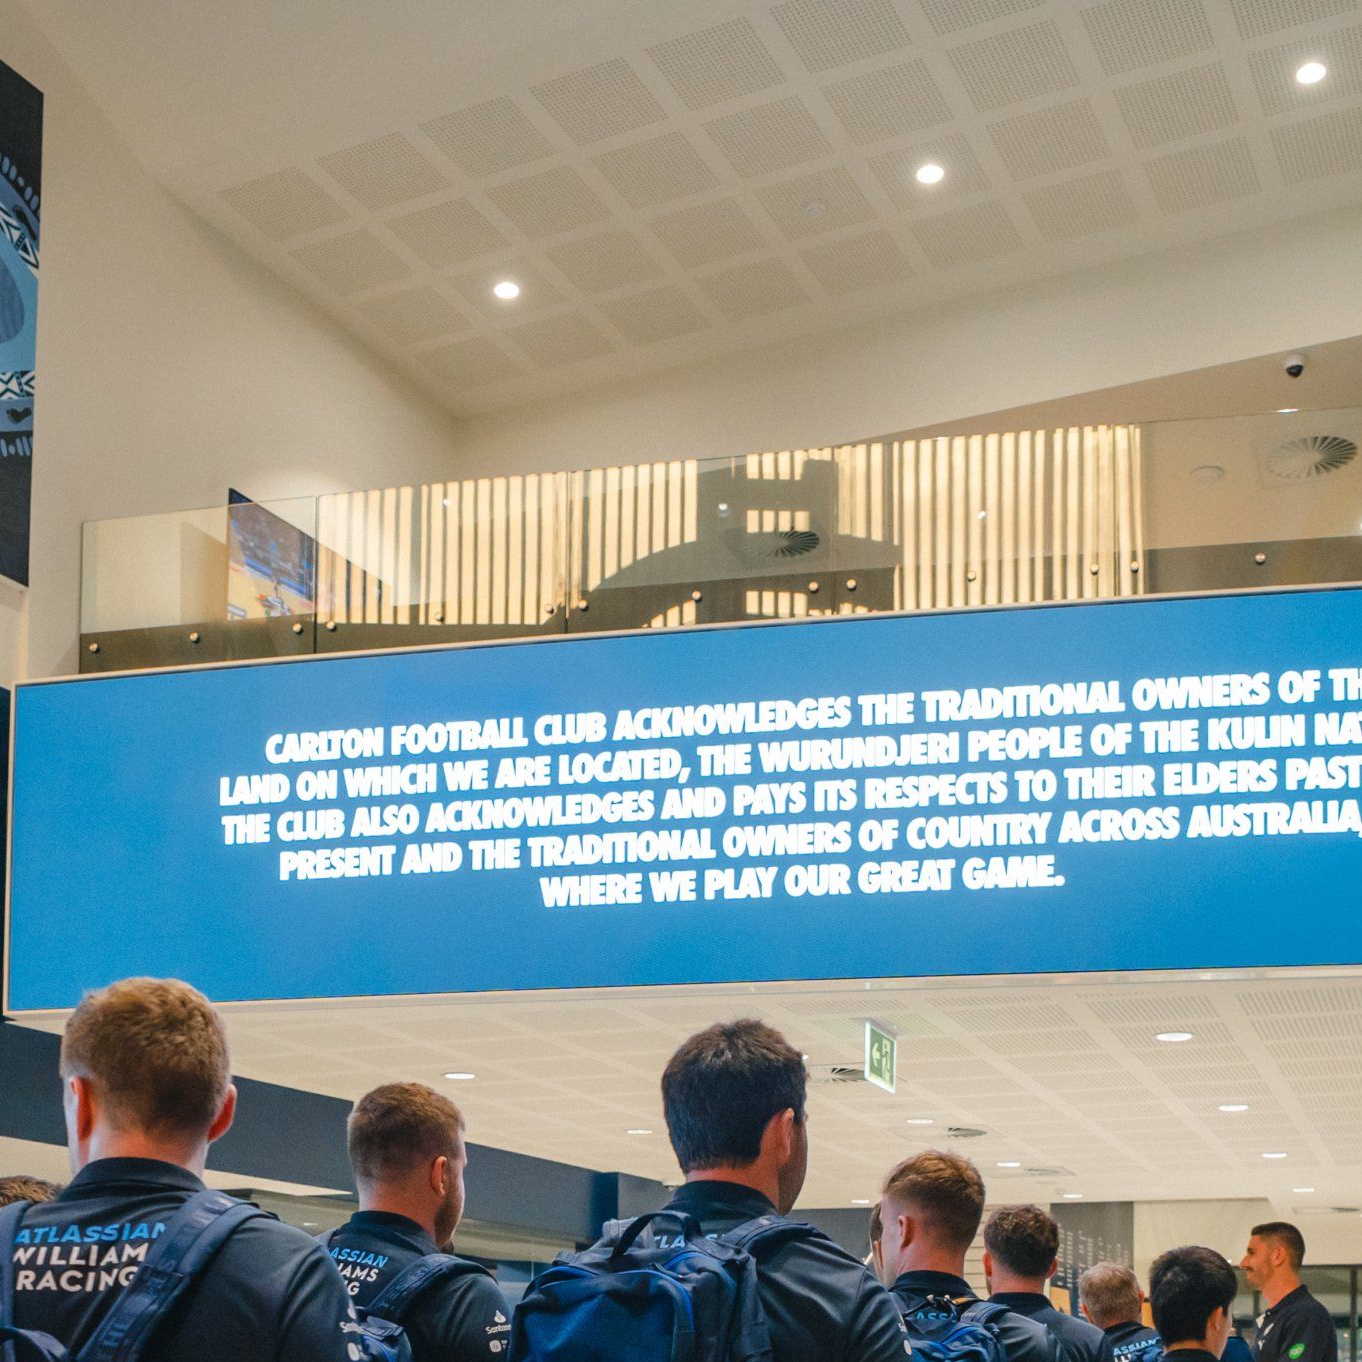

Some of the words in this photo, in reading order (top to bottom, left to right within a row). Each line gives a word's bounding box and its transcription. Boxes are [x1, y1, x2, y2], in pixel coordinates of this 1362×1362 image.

[264, 725, 385, 764] CARLTON
[390, 716, 529, 756] FOOTBALL
[533, 711, 607, 746] CLUB
[611, 694, 852, 741] ACKNOWLEDGES
[856, 691, 915, 726] THE
[920, 679, 1126, 723] TRADITIONAL
[1131, 671, 1271, 712] OWNERS
[1277, 669, 1321, 704] OF
[218, 772, 291, 807] LAND
[294, 768, 338, 802] ON
[342, 762, 438, 798] WHICH
[442, 758, 489, 792] WE
[493, 754, 552, 789] ARE
[557, 747, 692, 785] LOCATED,
[696, 742, 752, 777] THE
[757, 730, 960, 773] WURUNDJERI
[967, 724, 1083, 763] PEOPLE
[1089, 721, 1133, 757] OF
[1138, 718, 1200, 754] THE
[1207, 713, 1306, 751] KULIN
[220, 812, 271, 845] THE
[276, 807, 346, 842] CLUB
[349, 803, 420, 838] ALSO
[424, 788, 655, 833] ACKNOWLEDGES
[659, 785, 727, 820] AND
[732, 780, 807, 817] PAYS
[813, 777, 858, 812] ITS
[863, 770, 1008, 810] RESPECTS
[1013, 768, 1058, 803] TO
[1062, 764, 1157, 800] THEIR
[1162, 757, 1278, 796] ELDERS
[278, 844, 397, 881] PRESENT
[400, 841, 463, 875] AND
[467, 837, 521, 871] THE
[526, 827, 717, 868] TRADITIONAL
[721, 820, 852, 858] OWNERS
[857, 818, 899, 852] OF
[905, 810, 1053, 850] COUNTRY
[1057, 805, 1181, 844] ACROSS
[538, 871, 643, 908] WHERE
[647, 869, 697, 903] WE
[703, 865, 779, 900] PLAY
[783, 862, 852, 897] OUR
[857, 857, 956, 894] GREAT
[961, 853, 1066, 890] GAME.
[13, 1242, 149, 1266] WILLIAM
[330, 1247, 388, 1268] ASSIAN
[1113, 1337, 1157, 1356] ASSIAN
